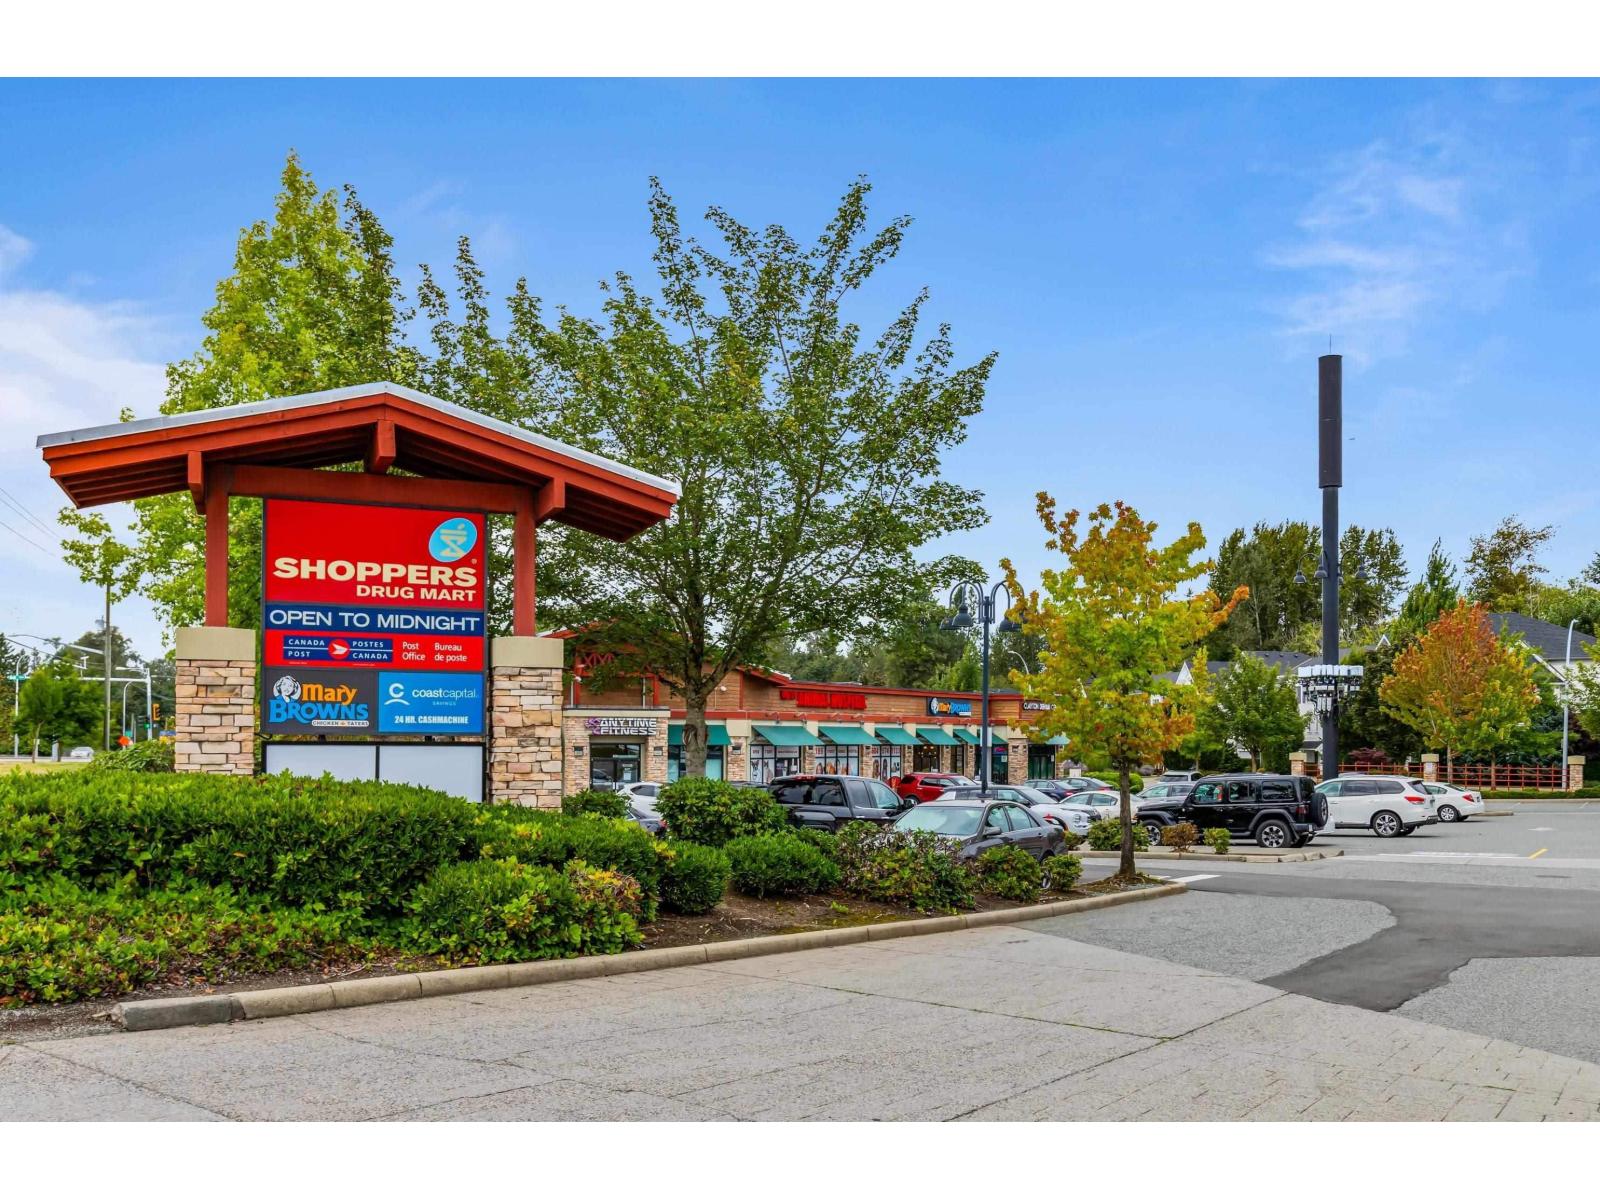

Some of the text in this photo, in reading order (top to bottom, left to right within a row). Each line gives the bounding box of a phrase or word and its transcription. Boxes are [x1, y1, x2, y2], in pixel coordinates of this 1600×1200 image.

[272, 557, 478, 587] SHOPPERS
[356, 584, 476, 602] DRUG MART
[269, 609, 480, 631] OPEN TO MIDNIGHT
[288, 638, 325, 646] CANADA
[352, 640, 384, 648] POSTES
[402, 641, 419, 650] Post
[434, 643, 462, 652] Bureau
[288, 650, 311, 658] POST
[352, 652, 388, 660] CANADA
[402, 652, 426, 661] Office
[434, 652, 468, 663] de poste
[269, 697, 369, 723] BROWNS
[394, 715, 404, 724] 24
[418, 715, 469, 724] CASHMACHINE
[600, 717, 657, 727] ANYTIME
[600, 727, 657, 736] FITNESS
